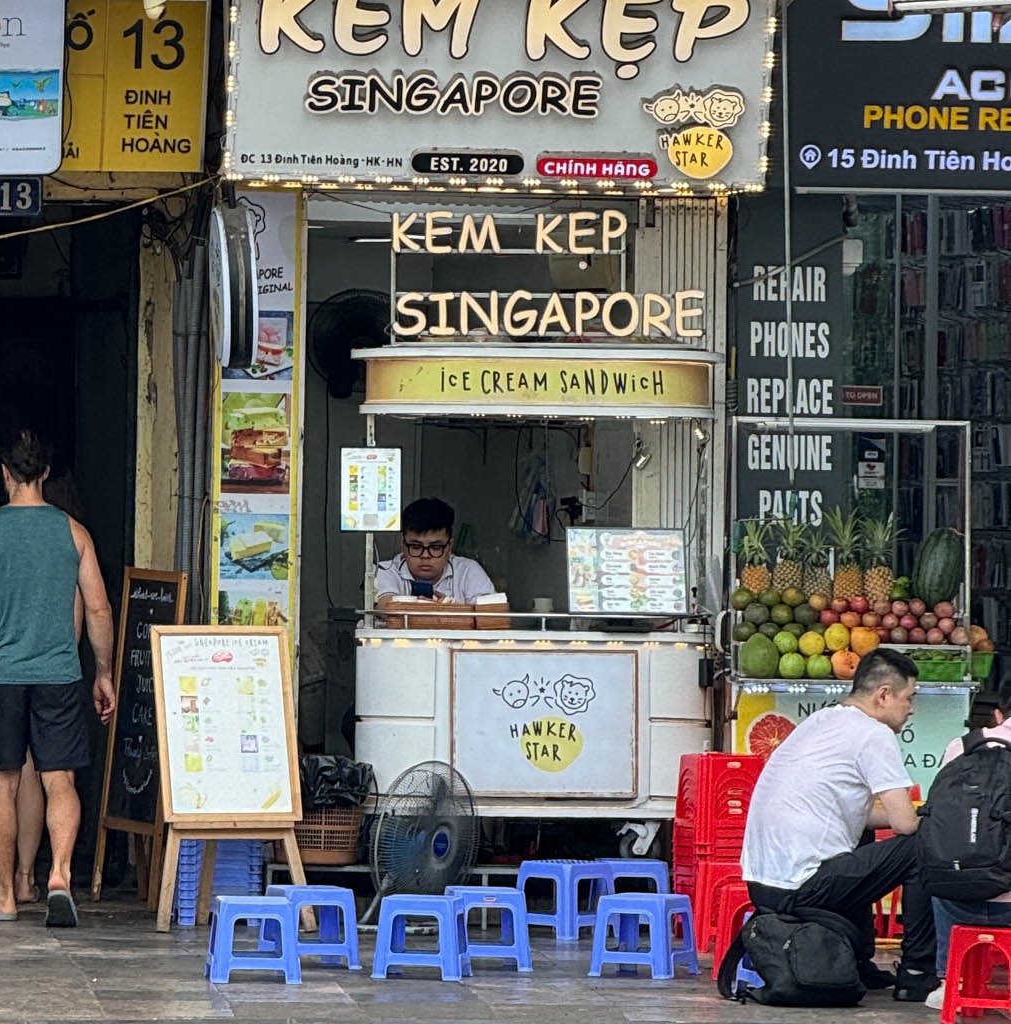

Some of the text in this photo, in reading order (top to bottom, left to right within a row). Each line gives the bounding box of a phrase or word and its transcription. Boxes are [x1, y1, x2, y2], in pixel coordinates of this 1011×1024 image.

[122, 18, 185, 70] 13
[930, 69, 1007, 101] AC
[125, 90, 171, 105] ĐINH
[306, 76, 602, 117] SINGAPORE
[124, 110, 168, 129] TIÊN
[863, 105, 969, 130] PHONE
[121, 132, 191, 153] HOÀNG
[661, 132, 725, 150] HAWKER
[240, 154, 255, 164] ĐC
[261, 154, 272, 164] 13
[429, 157, 508, 173] EST. 2020
[675, 150, 709, 168] STAR
[828, 149, 855, 168] 15
[860, 149, 917, 169] Đinh
[923, 150, 975, 170] Tiên
[0, 182, 33, 211] 13
[392, 210, 501, 254] KEM
[257, 267, 284, 280] PORE
[257, 282, 294, 295] IGINAL
[392, 289, 705, 337] SINGAPORE
[750, 321, 830, 358] PHONES
[480, 369, 548, 394] CREAM
[747, 378, 833, 414] REPLACE
[748, 433, 832, 471] GENUINE
[136, 676, 154, 694] JUIC
[510, 720, 576, 743] HAWKER
[901, 723, 914, 743] Ố
[526, 742, 561, 761] STAR
